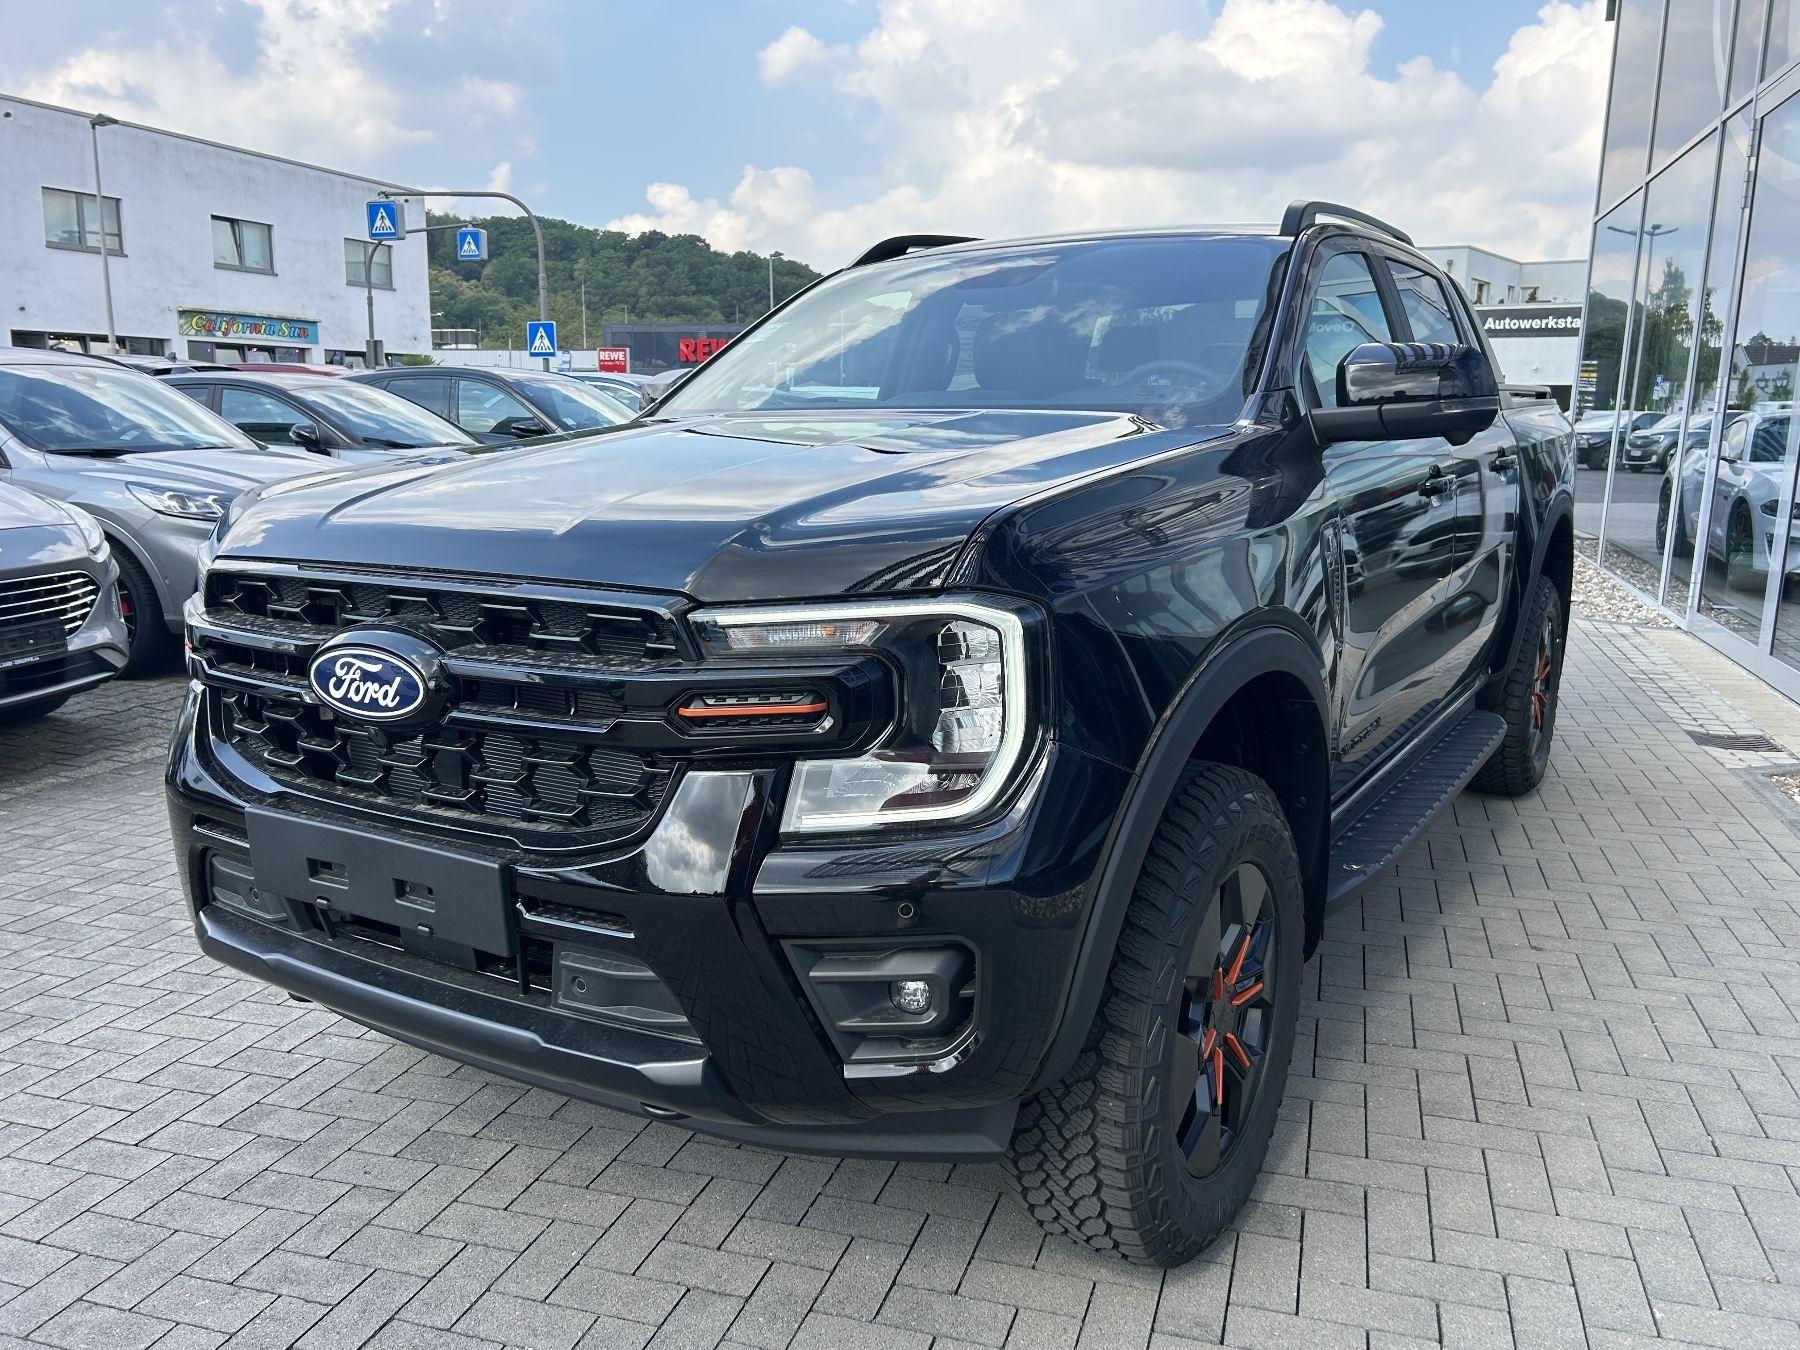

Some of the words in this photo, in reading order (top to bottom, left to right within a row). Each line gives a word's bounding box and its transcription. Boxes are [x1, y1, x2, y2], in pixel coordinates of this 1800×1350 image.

[191, 315, 276, 337] California
[279, 321, 310, 339] Sun
[599, 351, 626, 361] REWE
[328, 657, 402, 708] Ford
